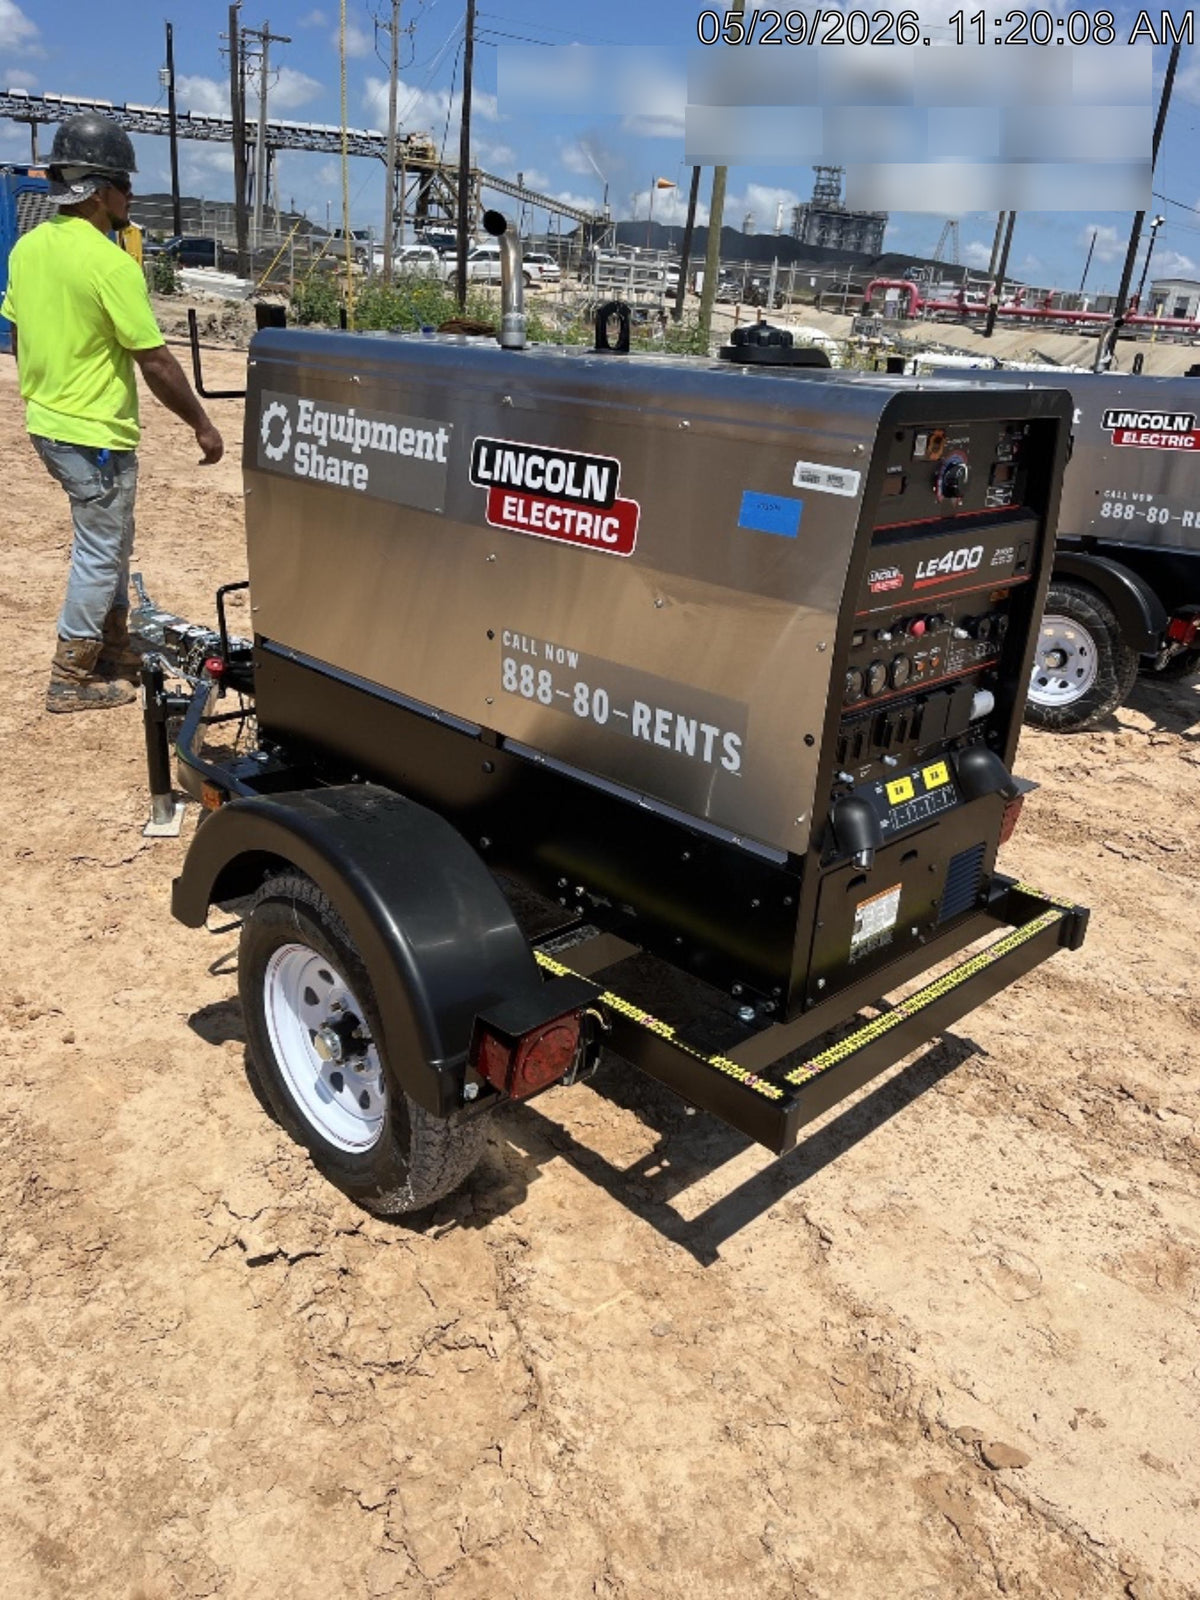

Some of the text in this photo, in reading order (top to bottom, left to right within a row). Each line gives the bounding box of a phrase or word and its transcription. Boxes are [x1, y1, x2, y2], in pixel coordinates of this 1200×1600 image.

[296, 400, 449, 463] Equipment
[1107, 412, 1190, 431] LINCOLN
[1122, 431, 1195, 447] ELECTRIC
[294, 442, 368, 491] Share
[477, 445, 610, 502] LINCOLN
[502, 495, 620, 544] ELECTRIC
[915, 546, 984, 579] LE400
[502, 630, 579, 669] CALL NOW
[502, 657, 742, 772] 888-80-RENTS
